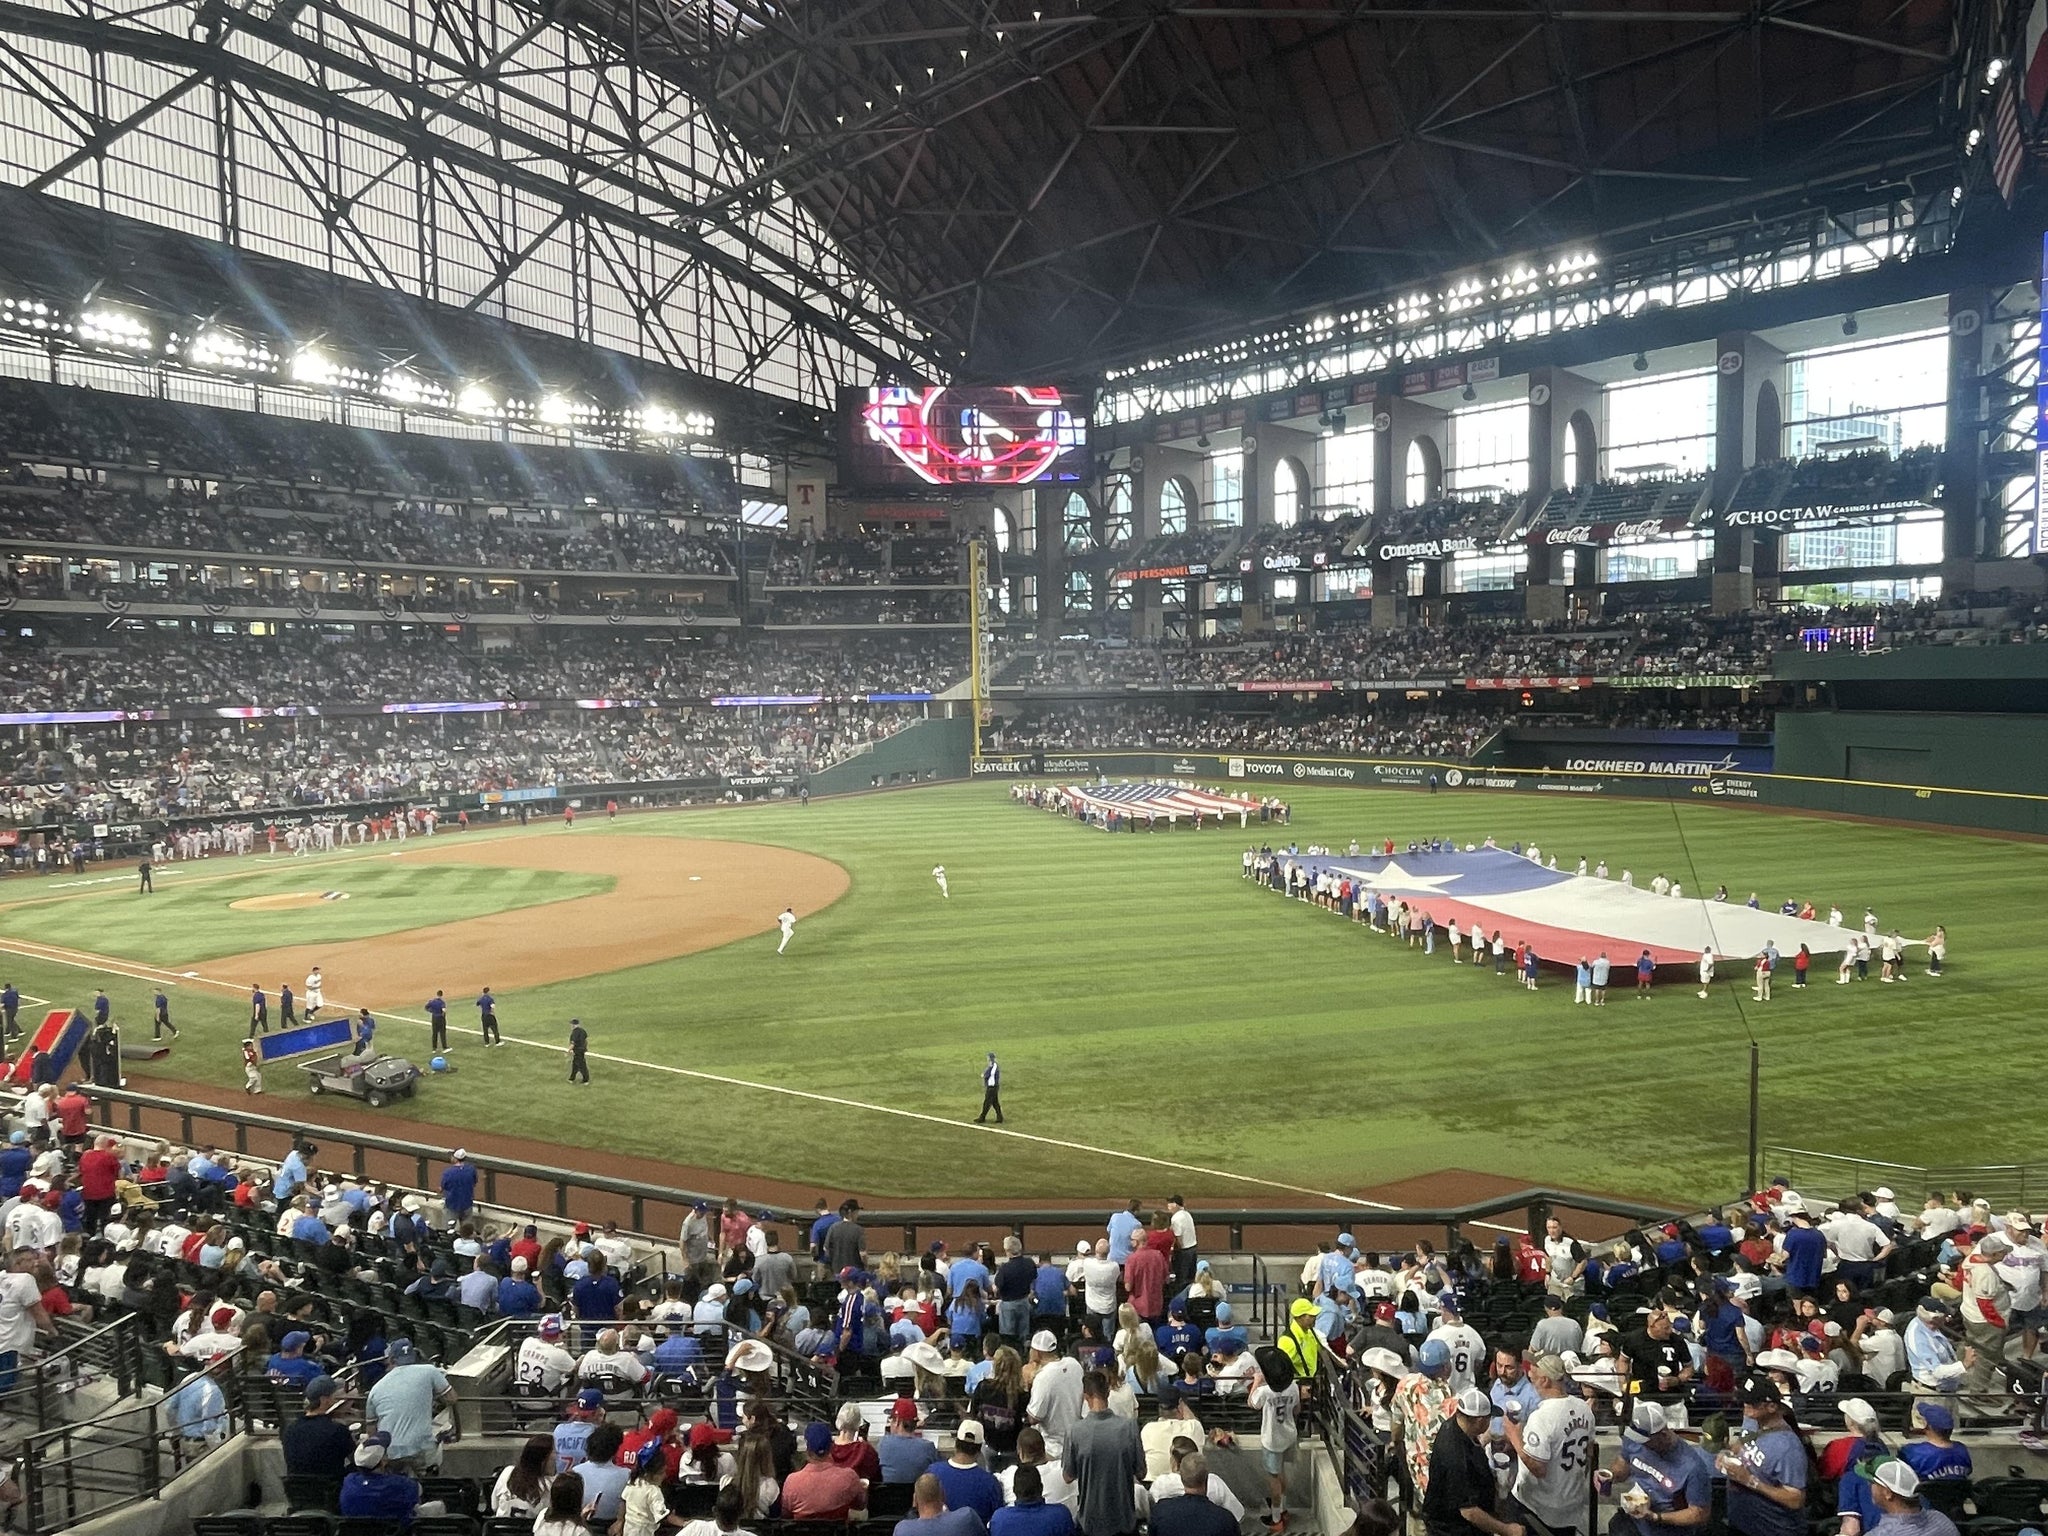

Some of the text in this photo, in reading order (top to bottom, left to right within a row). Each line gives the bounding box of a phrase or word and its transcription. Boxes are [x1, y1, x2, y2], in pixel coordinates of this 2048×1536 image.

[1955, 313, 1975, 332] 10
[1471, 358, 1495, 371] 2023
[1721, 355, 1740, 371] 29
[1438, 366, 1460, 379] 2016
[1535, 388, 1546, 402] 7
[1376, 416, 1390, 429] 26
[797, 484, 814, 504] T
[1736, 504, 1834, 526] CHOCTAW
[1833, 504, 1871, 514] CASINOS
[1546, 525, 1593, 544] Coca-Cola
[1614, 518, 1663, 538] Coca-Cola
[1442, 536, 1478, 552] Bank
[1263, 555, 1302, 569] QuikTrip
[1313, 552, 1326, 564] QT
[1240, 559, 1251, 571] QT
[1117, 565, 1190, 581] CORE PERSONNEL
[1623, 675, 1753, 688] LUXOR STAFFING
[128, 712, 139, 720] VS
[973, 761, 1020, 773] SEATGEEK
[1246, 764, 1284, 775] TOYOTA
[1306, 765, 1355, 779] Medical City
[1379, 766, 1424, 776] CHOCTAW
[1565, 759, 1713, 775] LOCKHEED MARTIN
[730, 777, 770, 786] VICTORY
[1726, 779, 1752, 789] ENERGY
[1691, 785, 1708, 794] 410
[1726, 788, 1758, 798] TRANSFER
[111, 825, 141, 834] TOYOTA
[281, 1219, 289, 1232] 2
[161, 1241, 168, 1254] 5
[1380, 1306, 1387, 1314] T
[402, 1345, 409, 1354] T
[1422, 1351, 1429, 1361] T
[1662, 1346, 1675, 1362] T
[1455, 1353, 1468, 1372] 6
[520, 1361, 544, 1383] 23
[578, 1398, 586, 1408] T
[1275, 1406, 1286, 1424] 5
[557, 1436, 587, 1449] PACIFI
[1560, 1435, 1589, 1472] 53
[1632, 1457, 1664, 1483] RANGERS
